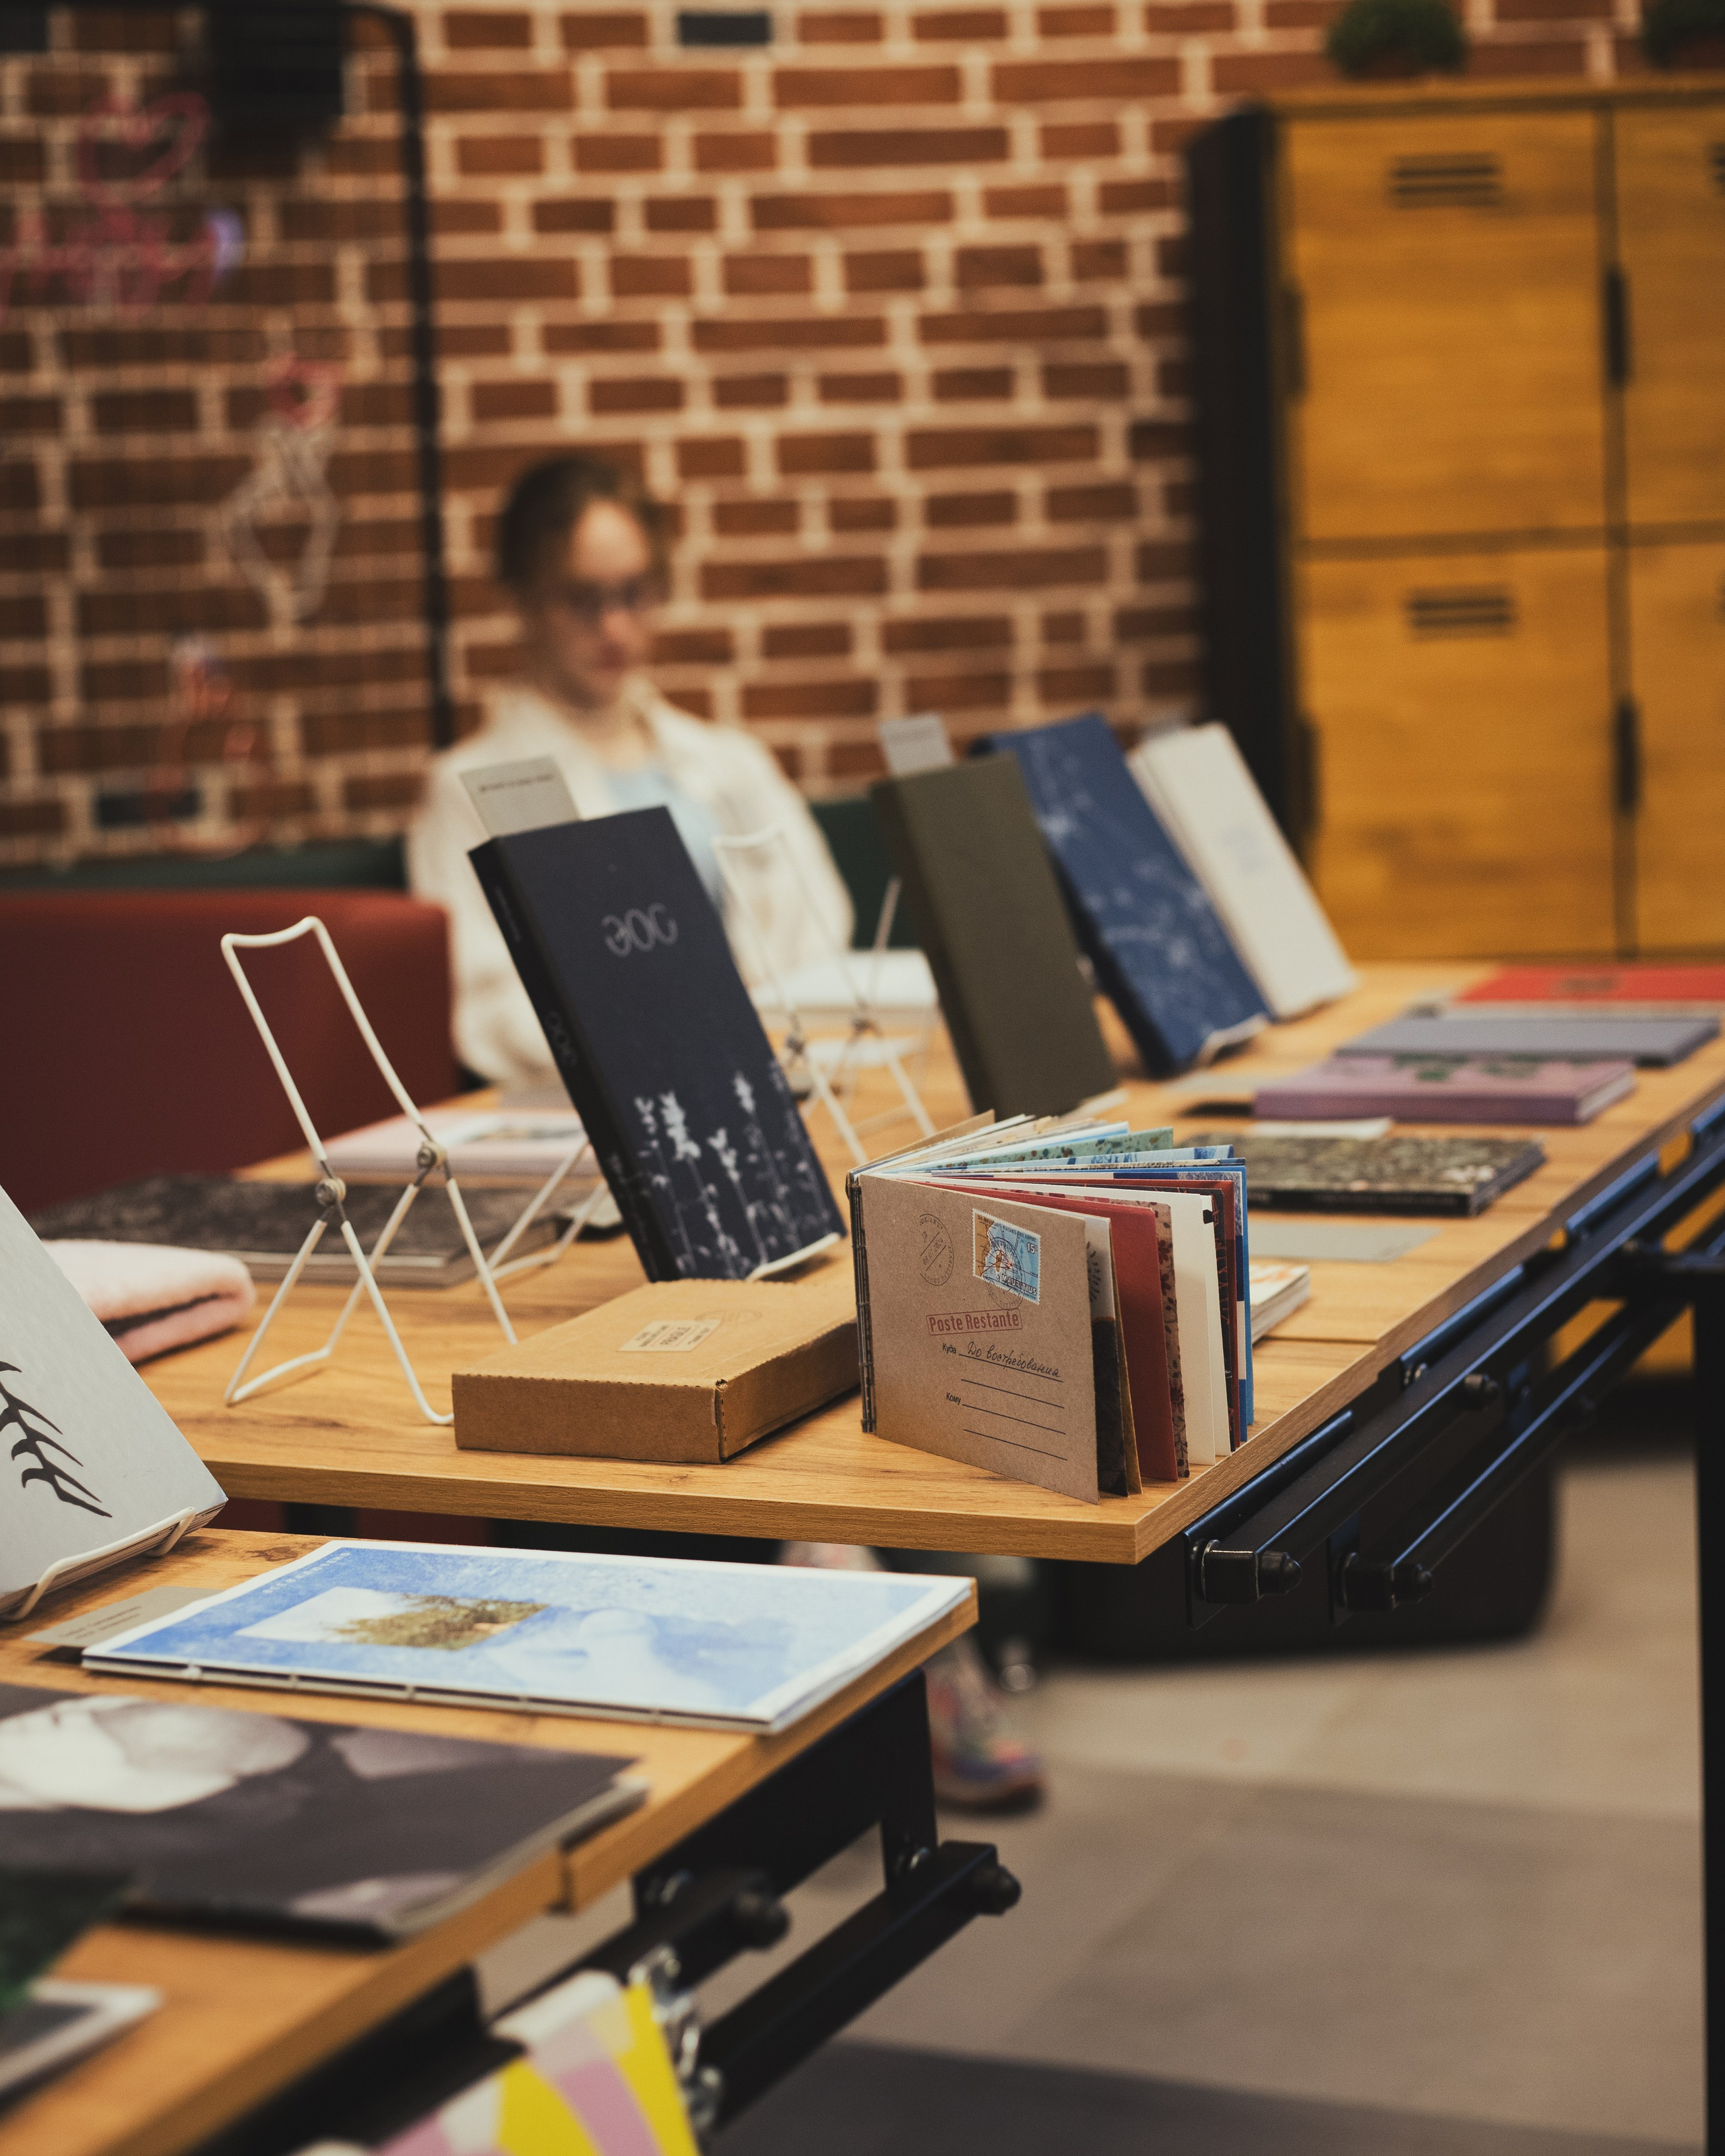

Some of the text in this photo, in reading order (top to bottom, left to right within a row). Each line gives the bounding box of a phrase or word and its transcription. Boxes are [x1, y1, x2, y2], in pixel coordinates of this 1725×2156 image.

[929, 1310, 1020, 1333] Poste Restante
[943, 1343, 957, 1354] Куда
[968, 1341, 982, 1358] До
[946, 1392, 962, 1405] Кому
